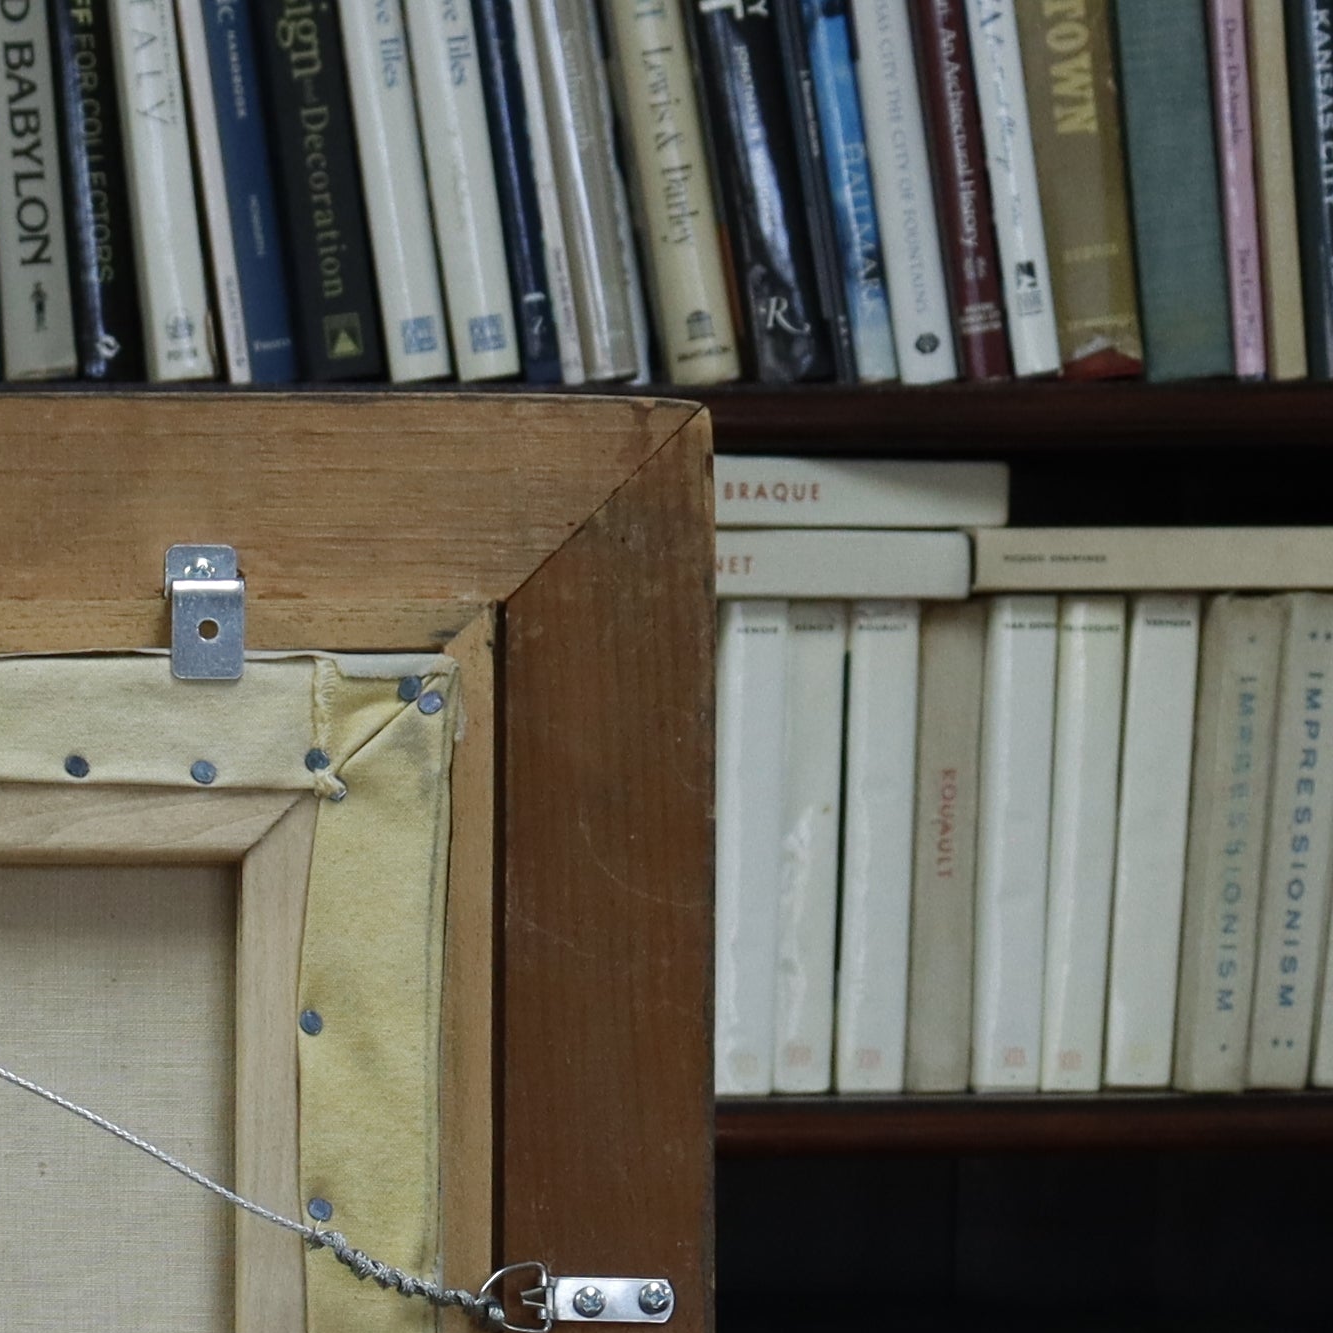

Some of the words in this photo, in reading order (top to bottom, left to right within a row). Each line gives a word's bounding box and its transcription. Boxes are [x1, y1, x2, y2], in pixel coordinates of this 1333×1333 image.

[73, 33, 98, 90] FOR
[381, 37, 402, 89] Tiles
[448, 34, 472, 86] Tiles
[640, 45, 680, 122] Lewis
[1310, 8, 1332, 138] KANSAS
[886, 88, 903, 122] THE
[944, 62, 974, 177] Architectural
[3, 40, 52, 266] BABYLON
[892, 130, 914, 170] CITY
[300, 105, 345, 299] Decoration
[899, 178, 915, 200] OF
[958, 180, 980, 248] History
[901, 209, 926, 314] FOUNTAINS
[723, 482, 820, 503] BRAQUE
[936, 769, 957, 878] ROUAULT
[1217, 676, 1257, 1012] IMPRESSIONISM
[1279, 671, 1324, 1008] IMPRESSIONISM
